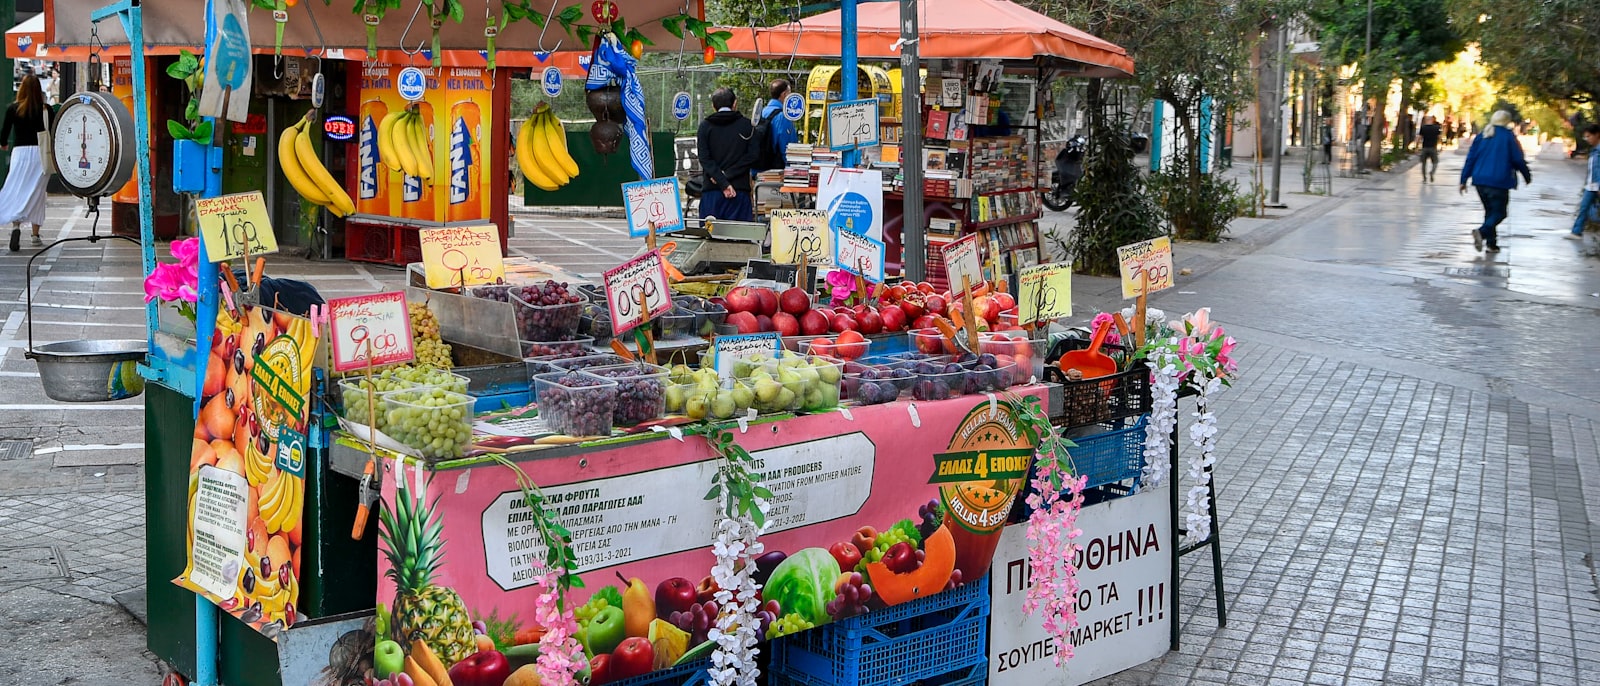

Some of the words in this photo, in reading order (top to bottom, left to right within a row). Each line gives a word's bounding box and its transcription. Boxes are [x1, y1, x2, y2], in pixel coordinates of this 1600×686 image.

[325, 121, 355, 134] OPEN
[449, 117, 468, 204] FANTA
[961, 411, 987, 440] HELLAS
[783, 461, 823, 477] PRODUCERS
[796, 476, 814, 487] FROM
[815, 470, 839, 483] MOTHER
[839, 465, 862, 478] NATURE
[938, 458, 973, 476] ΕΛΛΑΣ
[973, 453, 988, 478] 4
[564, 488, 600, 502] ΦΡΟΥΤΑ
[562, 505, 580, 516] ΑΠΟ
[950, 496, 978, 525] HELLAS
[979, 509, 988, 527] 4
[507, 526, 519, 538] ΜΕ
[606, 523, 622, 535] ΑΠΟ
[624, 521, 639, 532] ΤΗΝ
[640, 517, 661, 530] ΜΑΝΑ
[667, 514, 678, 525] ΓΗ
[510, 556, 522, 567] ΓΙΑ
[576, 540, 596, 553] ΥΓΕΙΑ
[597, 537, 612, 549] ΣΑΣ
[1097, 581, 1119, 606] ΤΑ
[1069, 611, 1133, 648] ΜΑΡΚΕΤ
